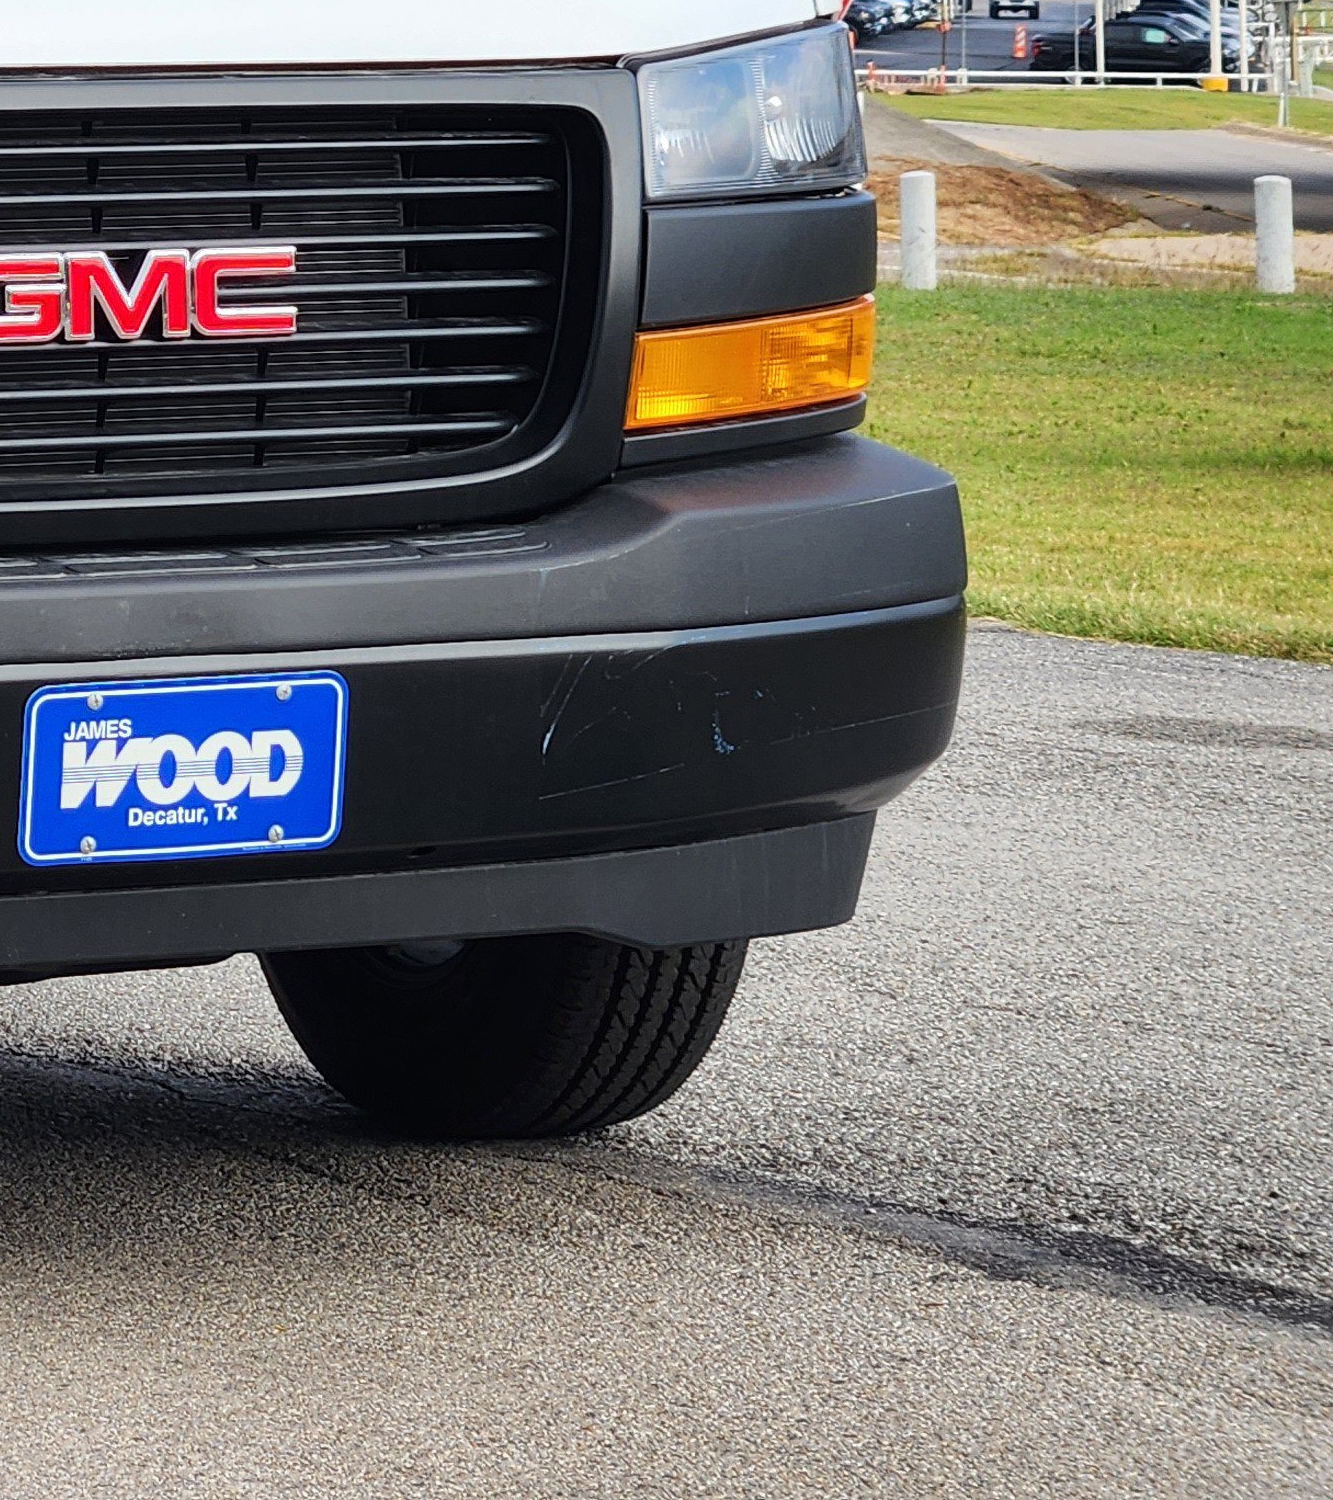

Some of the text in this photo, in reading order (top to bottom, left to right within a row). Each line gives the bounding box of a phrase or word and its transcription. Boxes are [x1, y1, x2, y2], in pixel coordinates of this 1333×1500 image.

[63, 718, 132, 741] JAMES
[60, 729, 304, 810] WOOD
[128, 802, 238, 827] Decatur, Tx
